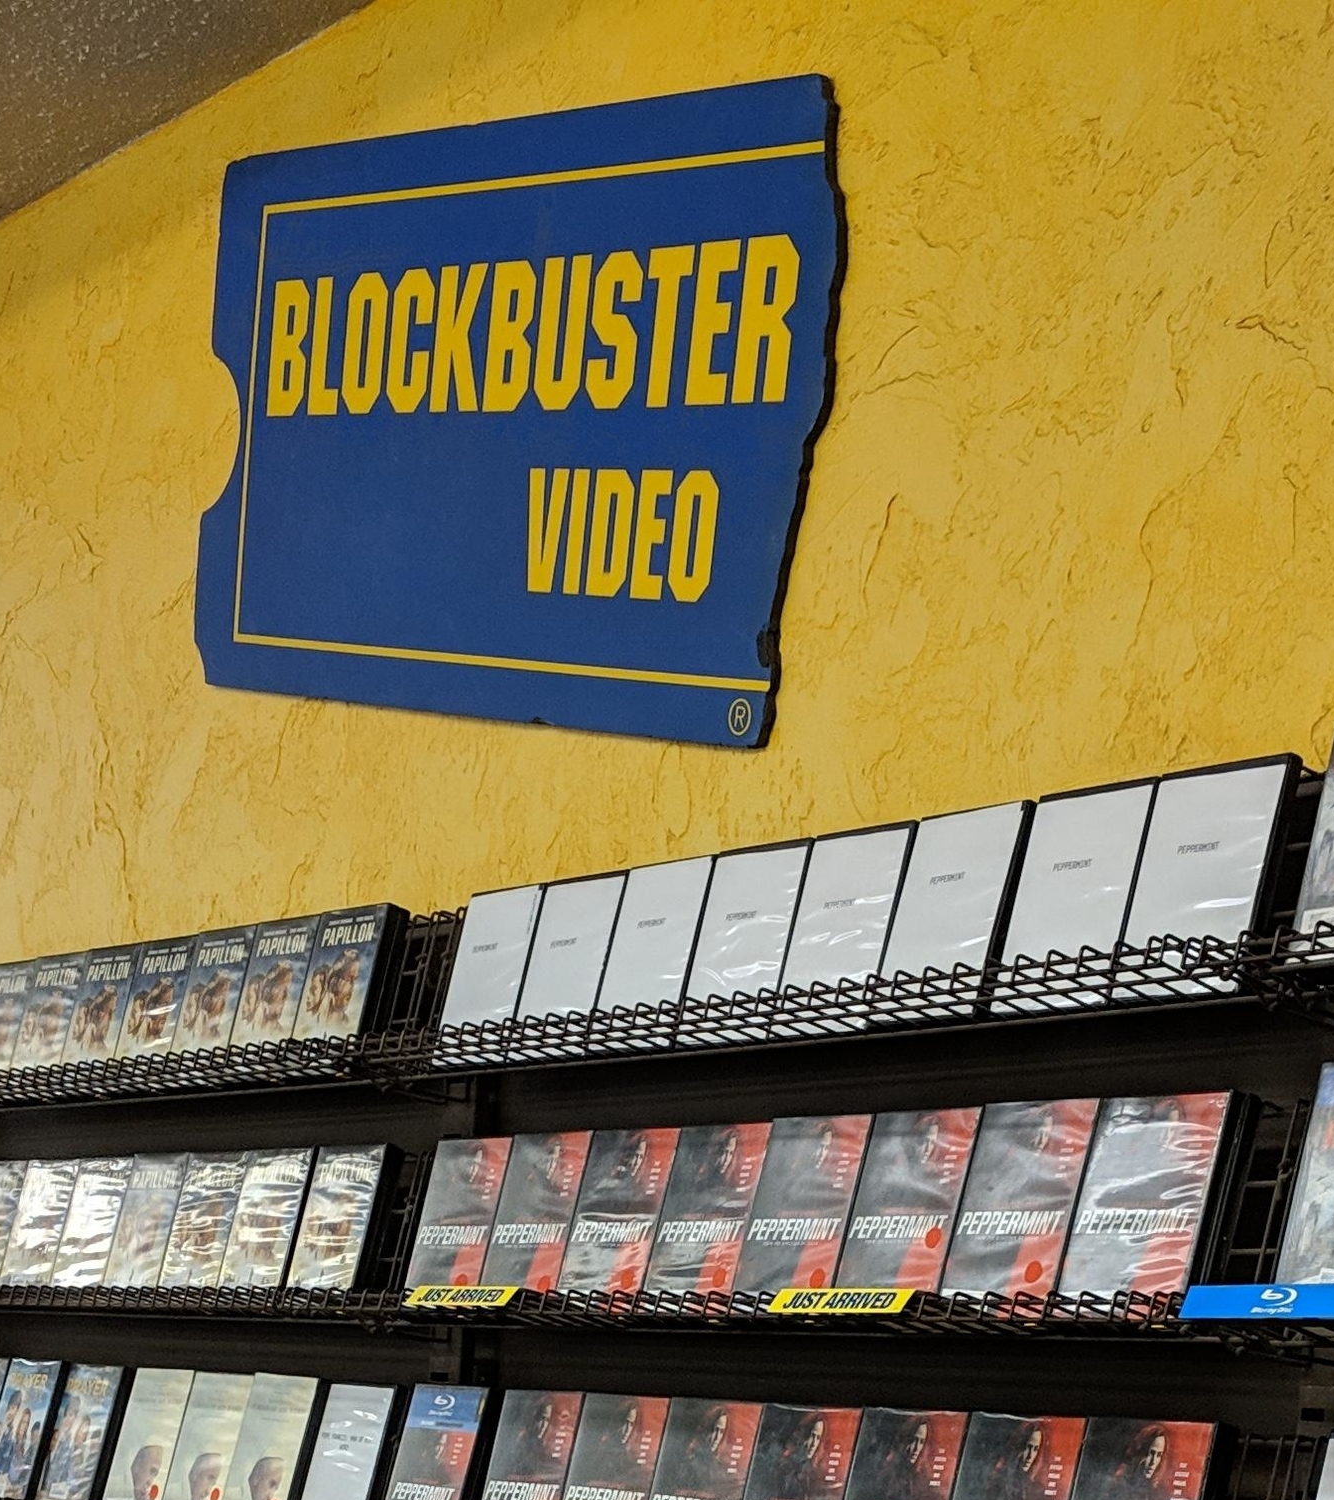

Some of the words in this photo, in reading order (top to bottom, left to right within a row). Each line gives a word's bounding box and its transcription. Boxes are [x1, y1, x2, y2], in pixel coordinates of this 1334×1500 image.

[266, 233, 801, 418] BLOCKBUSTER
[526, 467, 720, 603] VIDEO
[1177, 841, 1220, 855] PEPPERMINT
[1052, 858, 1093, 872] PEPPERMINT
[929, 871, 966, 885] PEPPERMINT
[257, 935, 307, 957] PAPILLON
[322, 923, 375, 947] PAPILLON
[141, 953, 187, 974] PAPILLON
[657, 1220, 745, 1243] PEPPERMINT
[746, 1217, 842, 1242] PEPPERMINT
[956, 1211, 1065, 1236] PEPPERMINT
[417, 1224, 489, 1246] PEPPERMINT
[783, 1292, 828, 1309] JUST
[825, 1292, 898, 1308] ARRIVED
